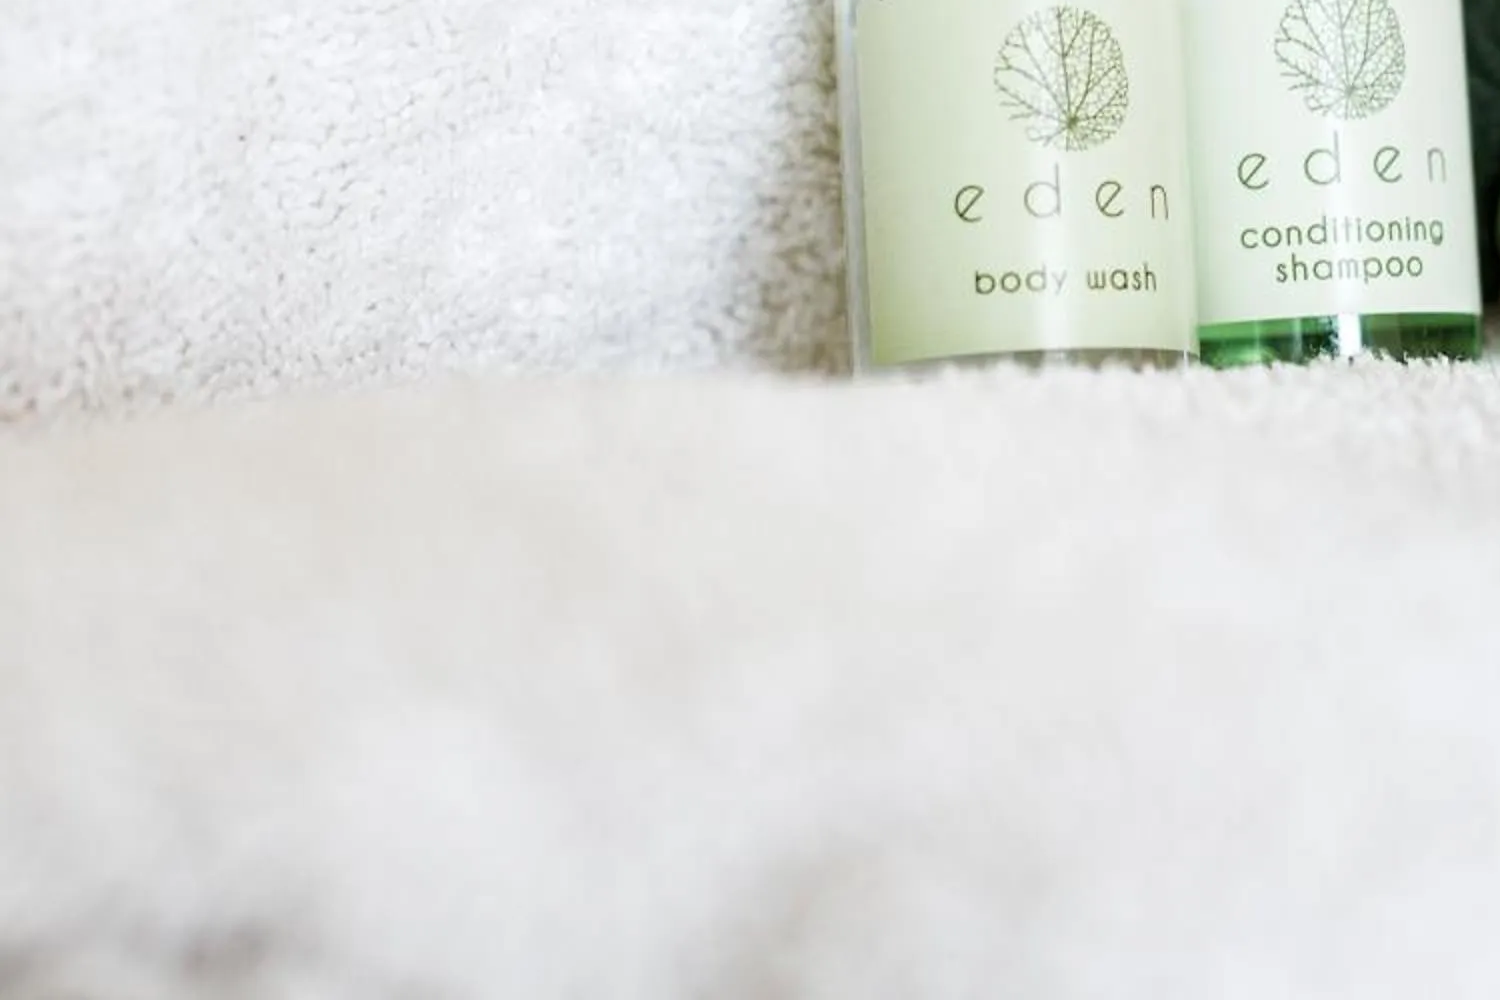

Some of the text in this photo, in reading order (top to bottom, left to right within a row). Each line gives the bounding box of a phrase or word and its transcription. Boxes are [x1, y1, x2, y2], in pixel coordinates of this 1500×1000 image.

[1237, 131, 1446, 190] eden
[954, 163, 1169, 223] eden
[1240, 214, 1444, 249] conditioning
[974, 262, 1158, 295] body wash
[1275, 253, 1424, 284] shampoo
